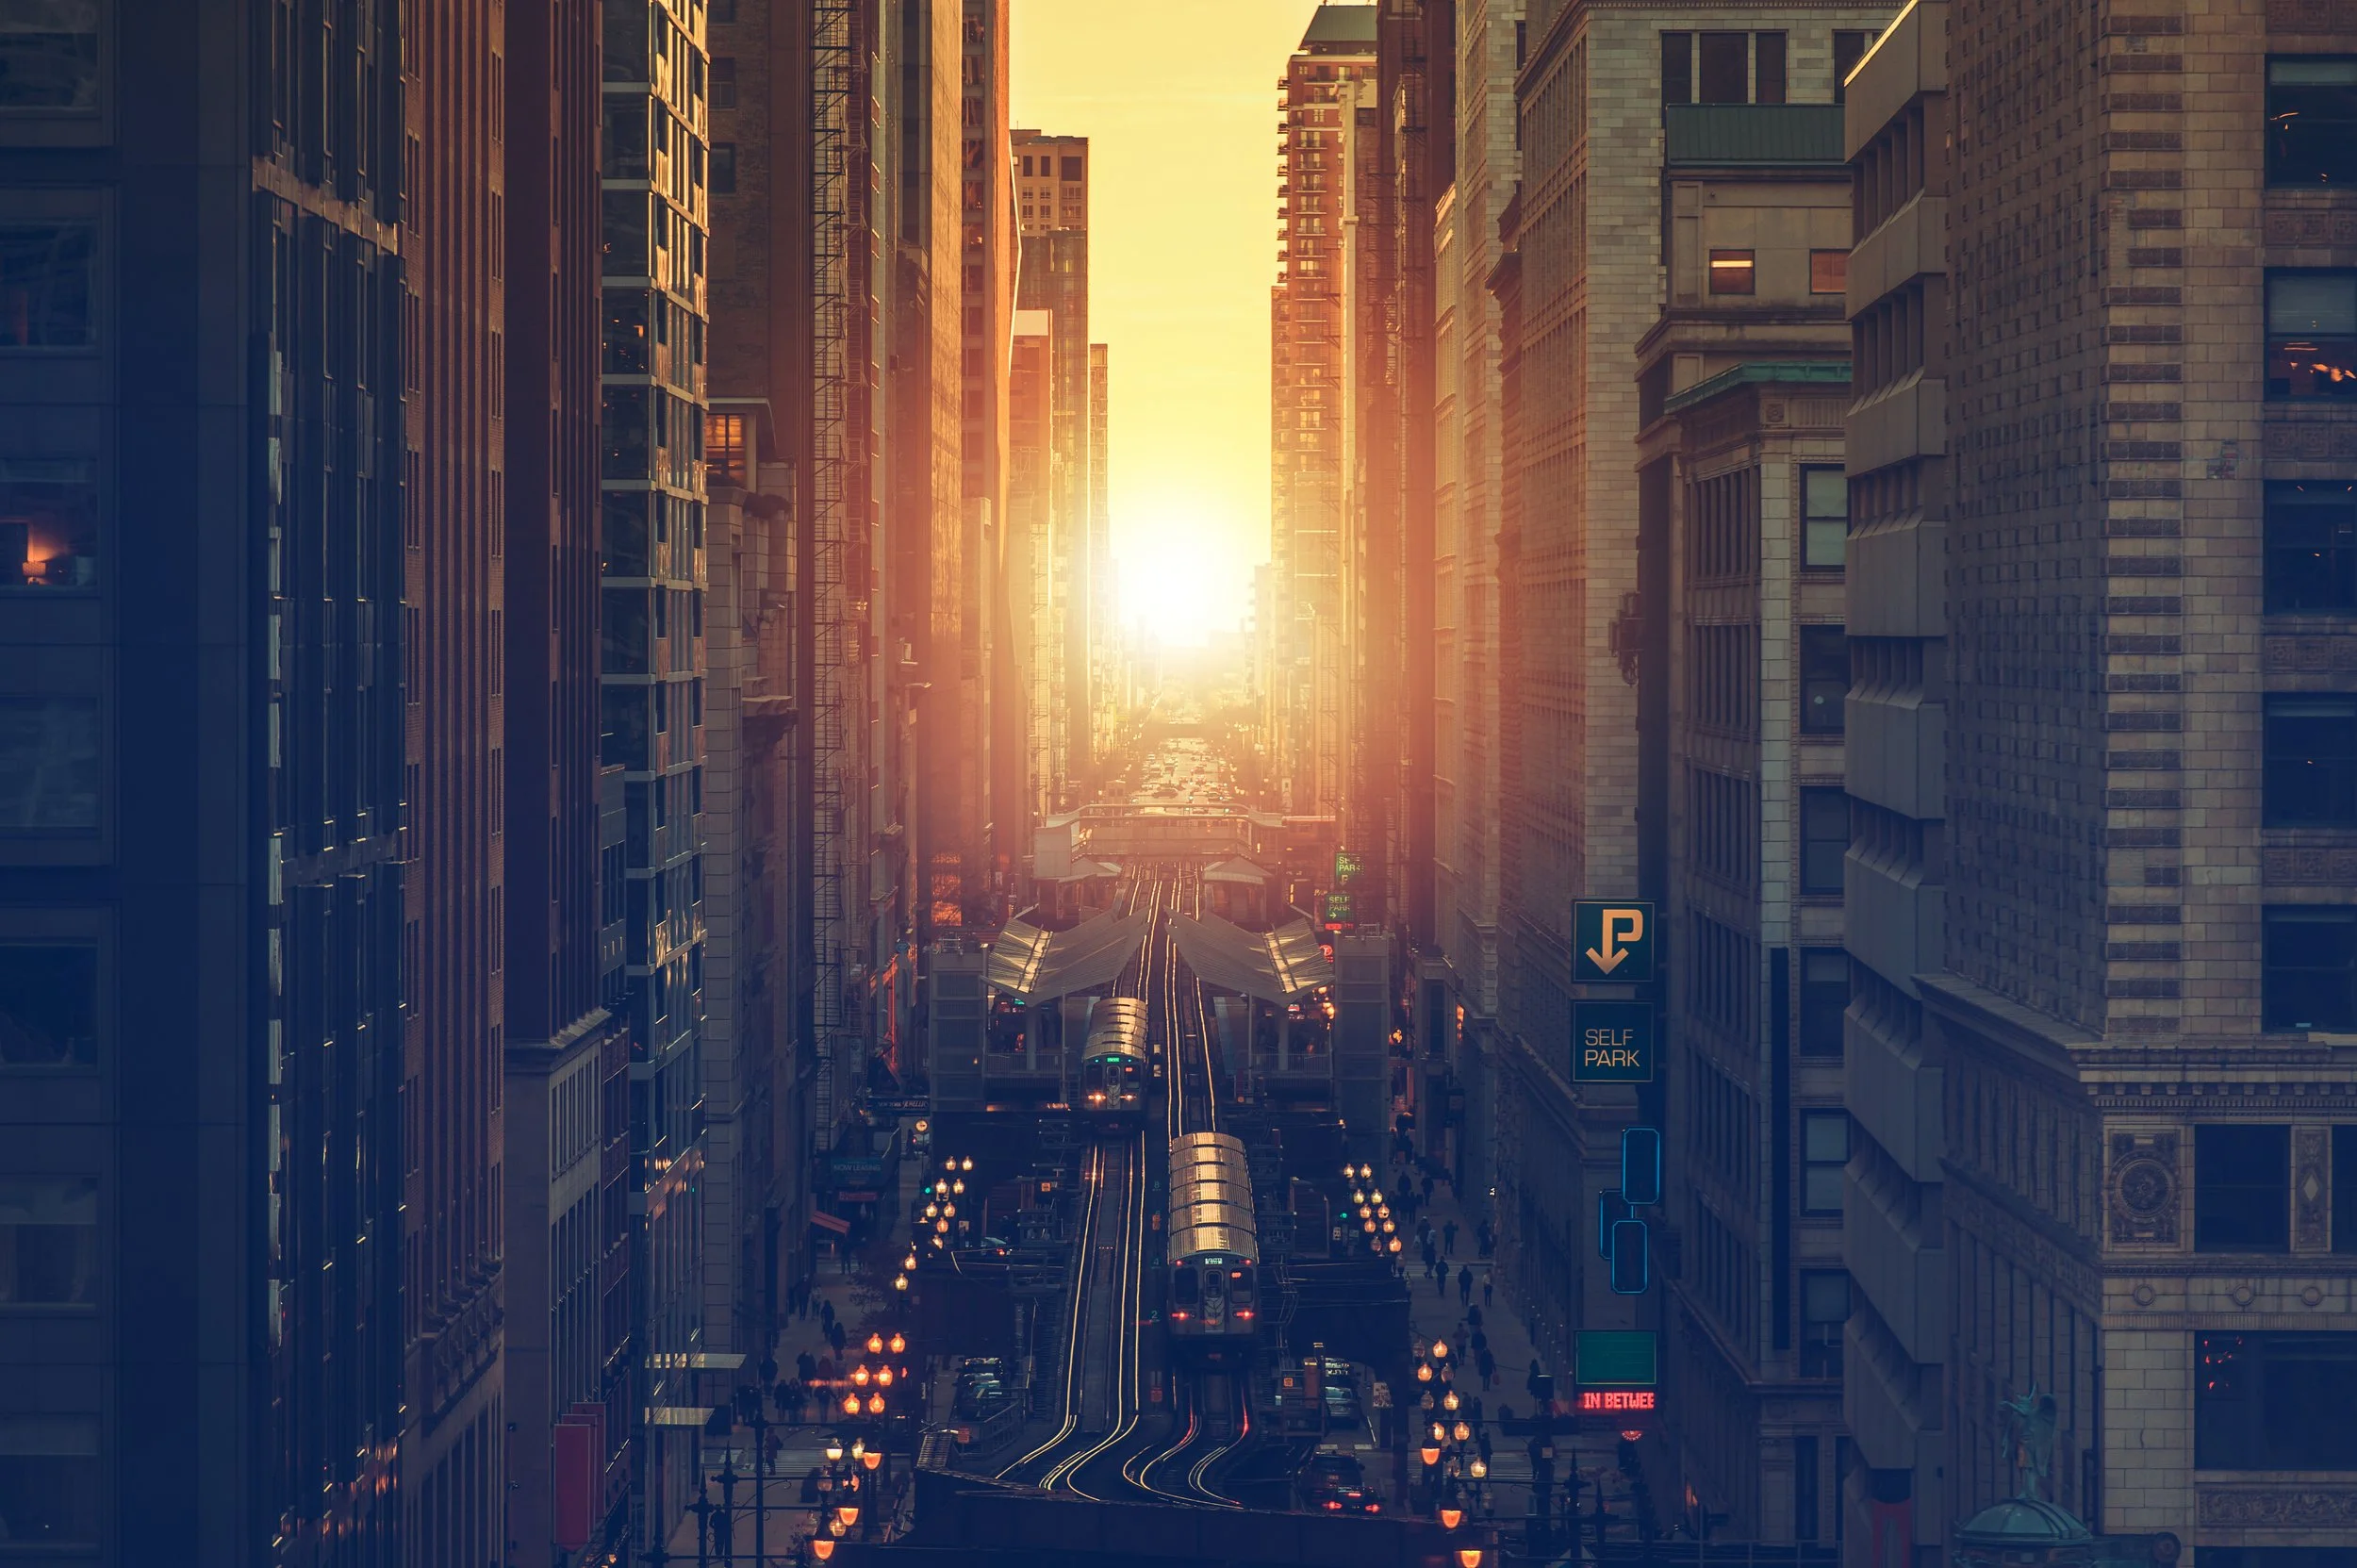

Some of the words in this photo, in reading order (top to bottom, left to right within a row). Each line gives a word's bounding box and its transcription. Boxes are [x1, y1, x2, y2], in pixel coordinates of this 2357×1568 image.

[1585, 1029, 1634, 1046] SELF
[1584, 1049, 1640, 1066] PARK
[1151, 1310, 1158, 1319] 2
[1583, 1392, 1600, 1410] IN
[1604, 1392, 1655, 1410] BETWEE
